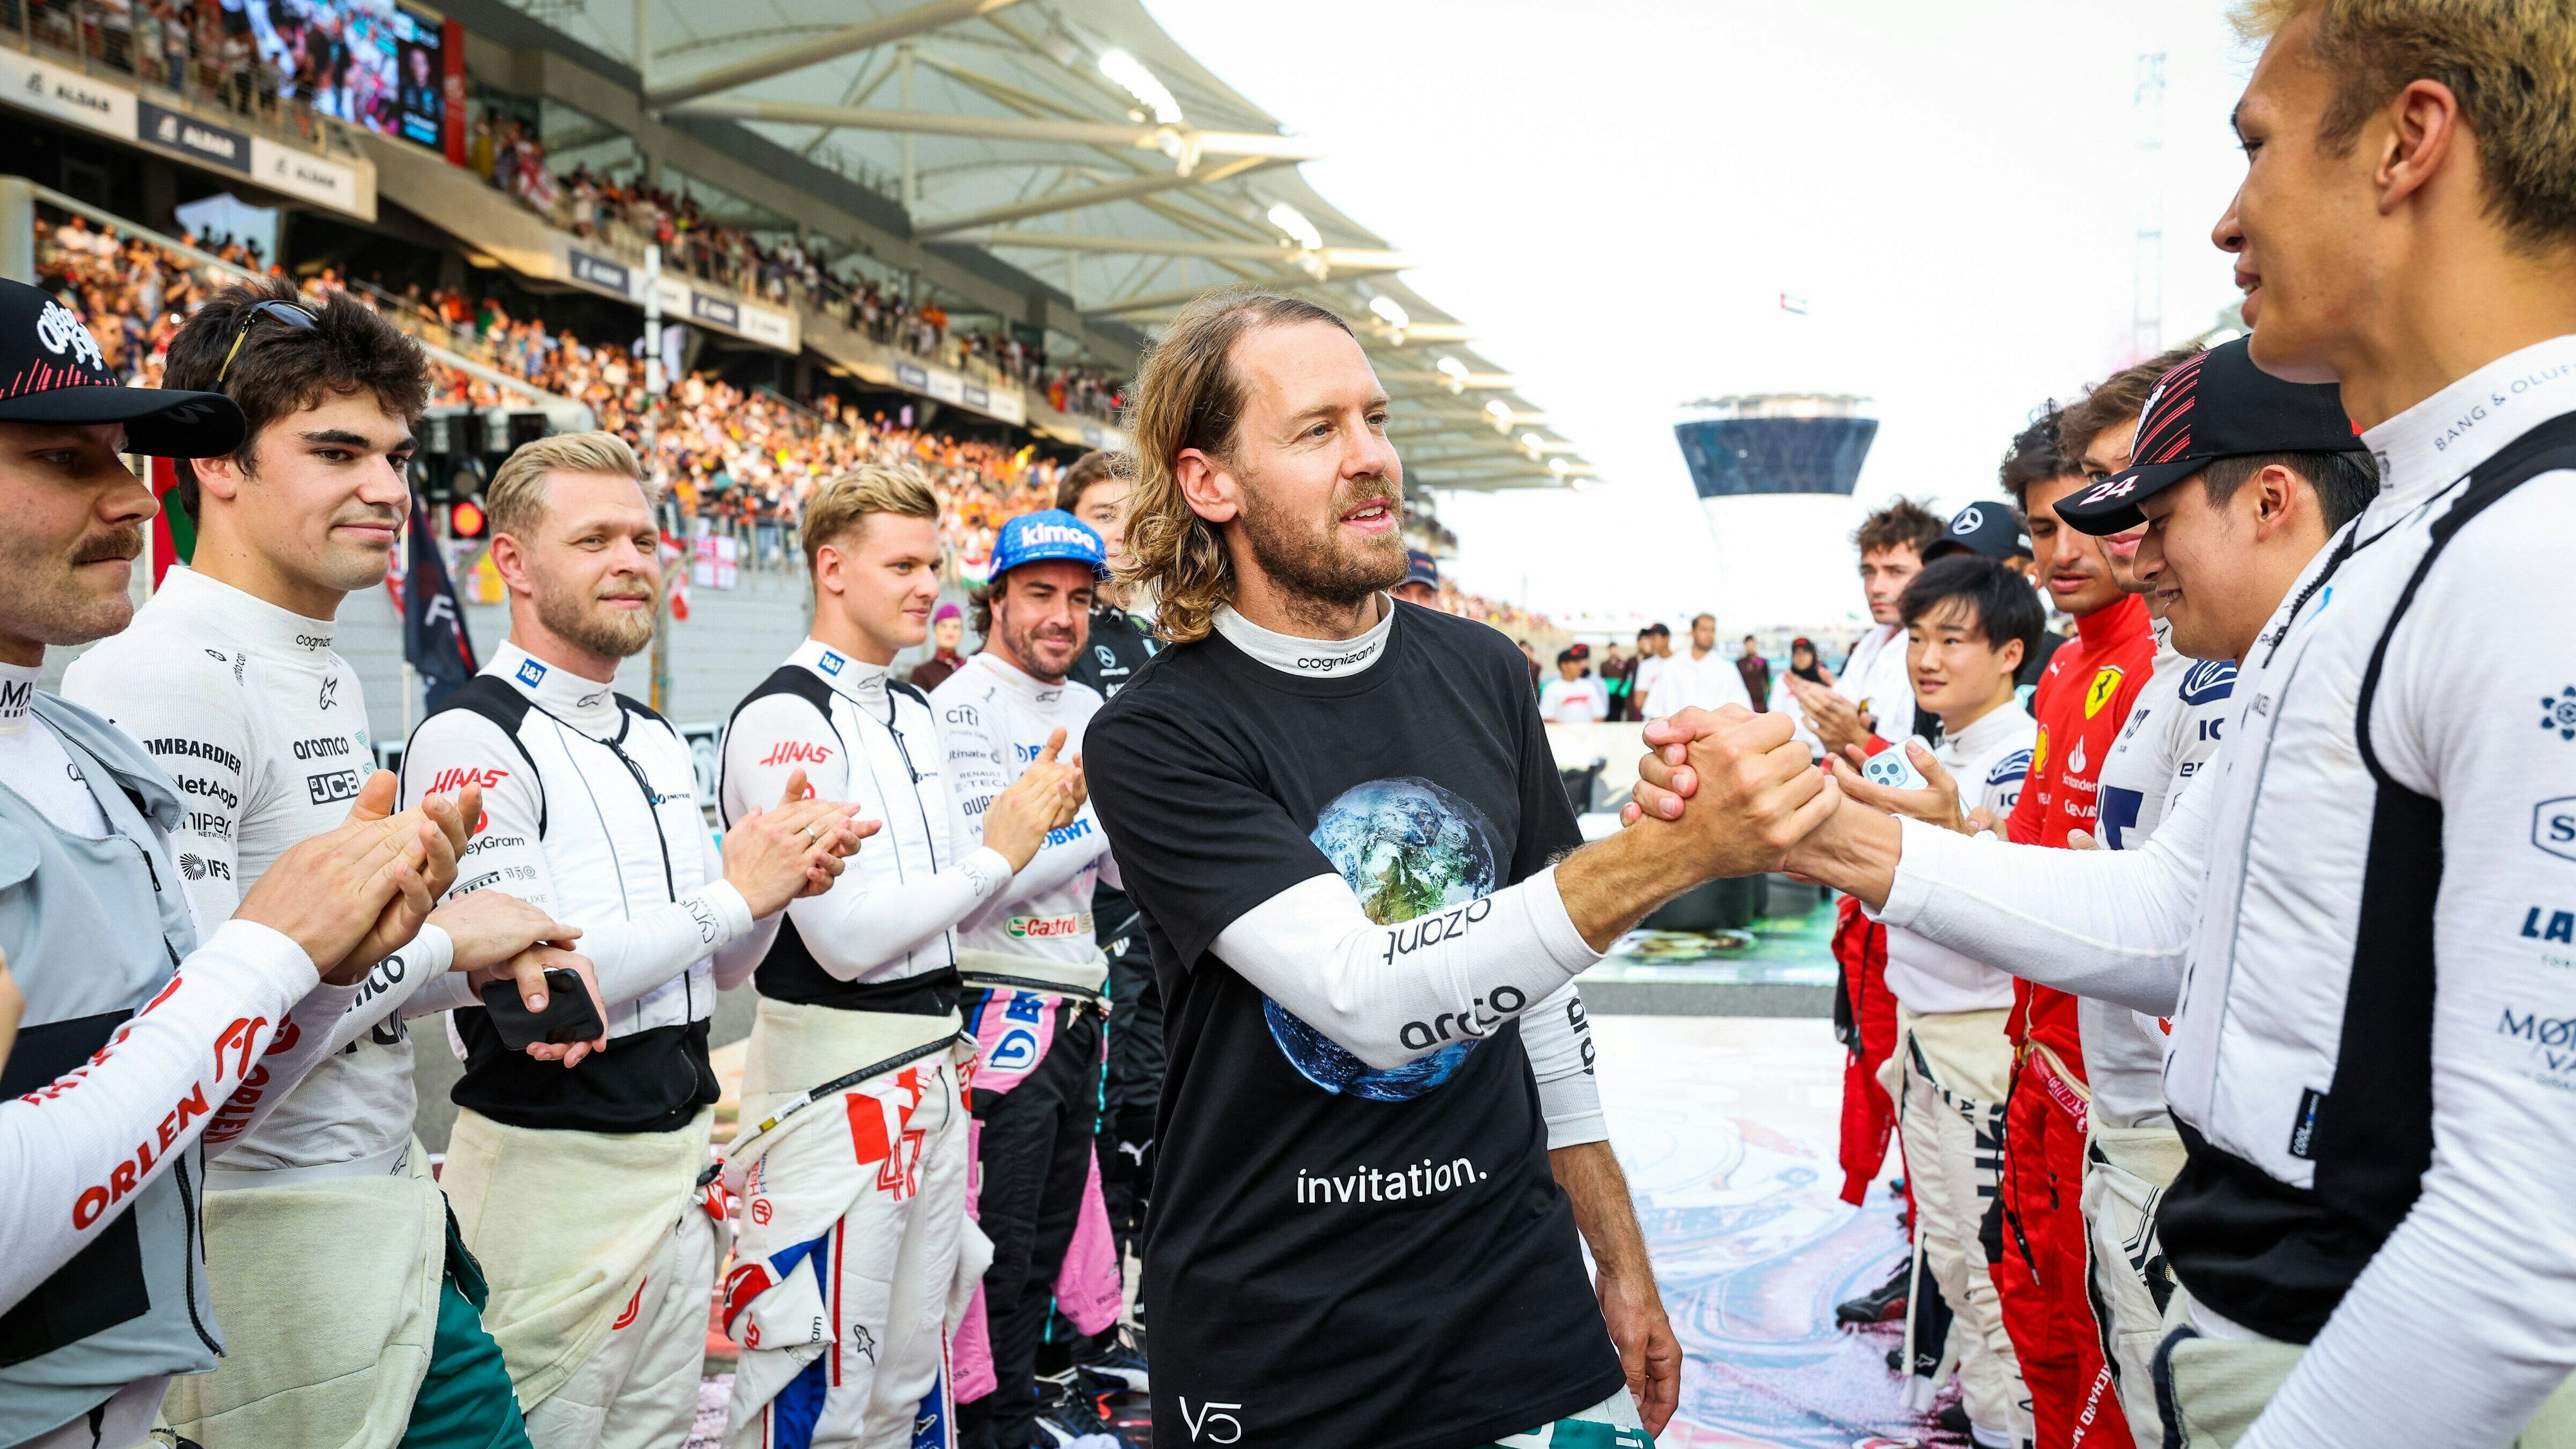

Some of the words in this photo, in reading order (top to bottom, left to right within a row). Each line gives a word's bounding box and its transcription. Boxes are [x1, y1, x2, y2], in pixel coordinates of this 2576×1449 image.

[2434, 405, 2486, 451] BANG
[2078, 474, 2140, 507] 24
[1021, 522, 1097, 553] kimoa
[1297, 641, 1377, 672] cognizant
[946, 704, 979, 726] citi
[143, 738, 242, 777] OMBARDIER
[293, 736, 349, 761] aramco
[759, 741, 835, 767] HAAS
[312, 771, 361, 803] JCB
[424, 768, 510, 797] HAAS
[463, 836, 526, 857] eyGram
[1052, 818, 1092, 846] BWT
[207, 858, 231, 881] IFS
[1027, 916, 1077, 937] Castrol
[71, 1083, 210, 1231] ORLEN
[876, 1128, 927, 1202] 47
[1296, 1154, 1488, 1205] invitation.
